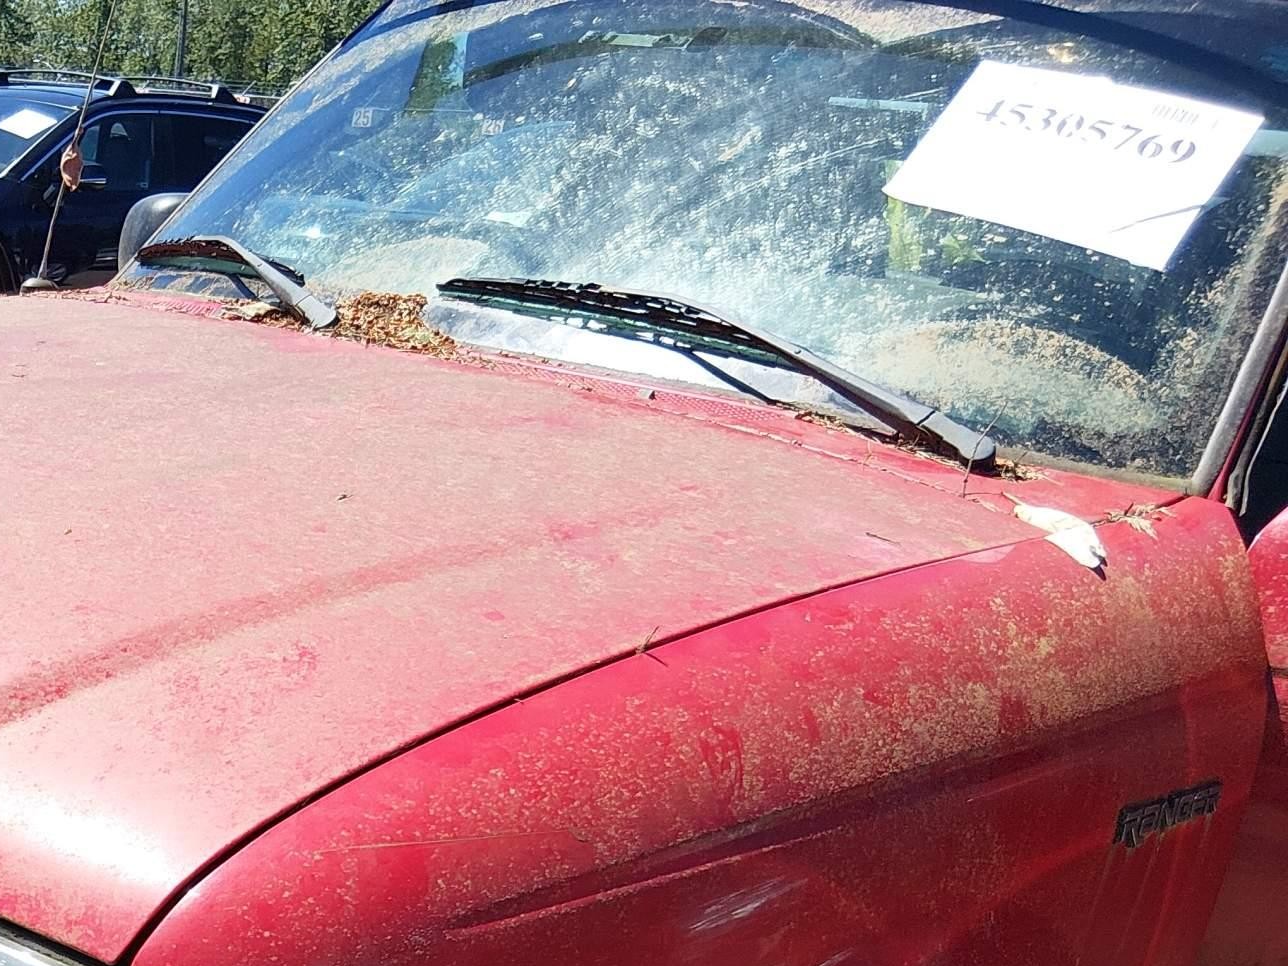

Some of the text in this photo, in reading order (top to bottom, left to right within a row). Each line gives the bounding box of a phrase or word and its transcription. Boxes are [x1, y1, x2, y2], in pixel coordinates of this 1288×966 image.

[353, 110, 370, 126] 25
[976, 98, 1197, 164] 45305769
[1114, 780, 1222, 848] RANGER
